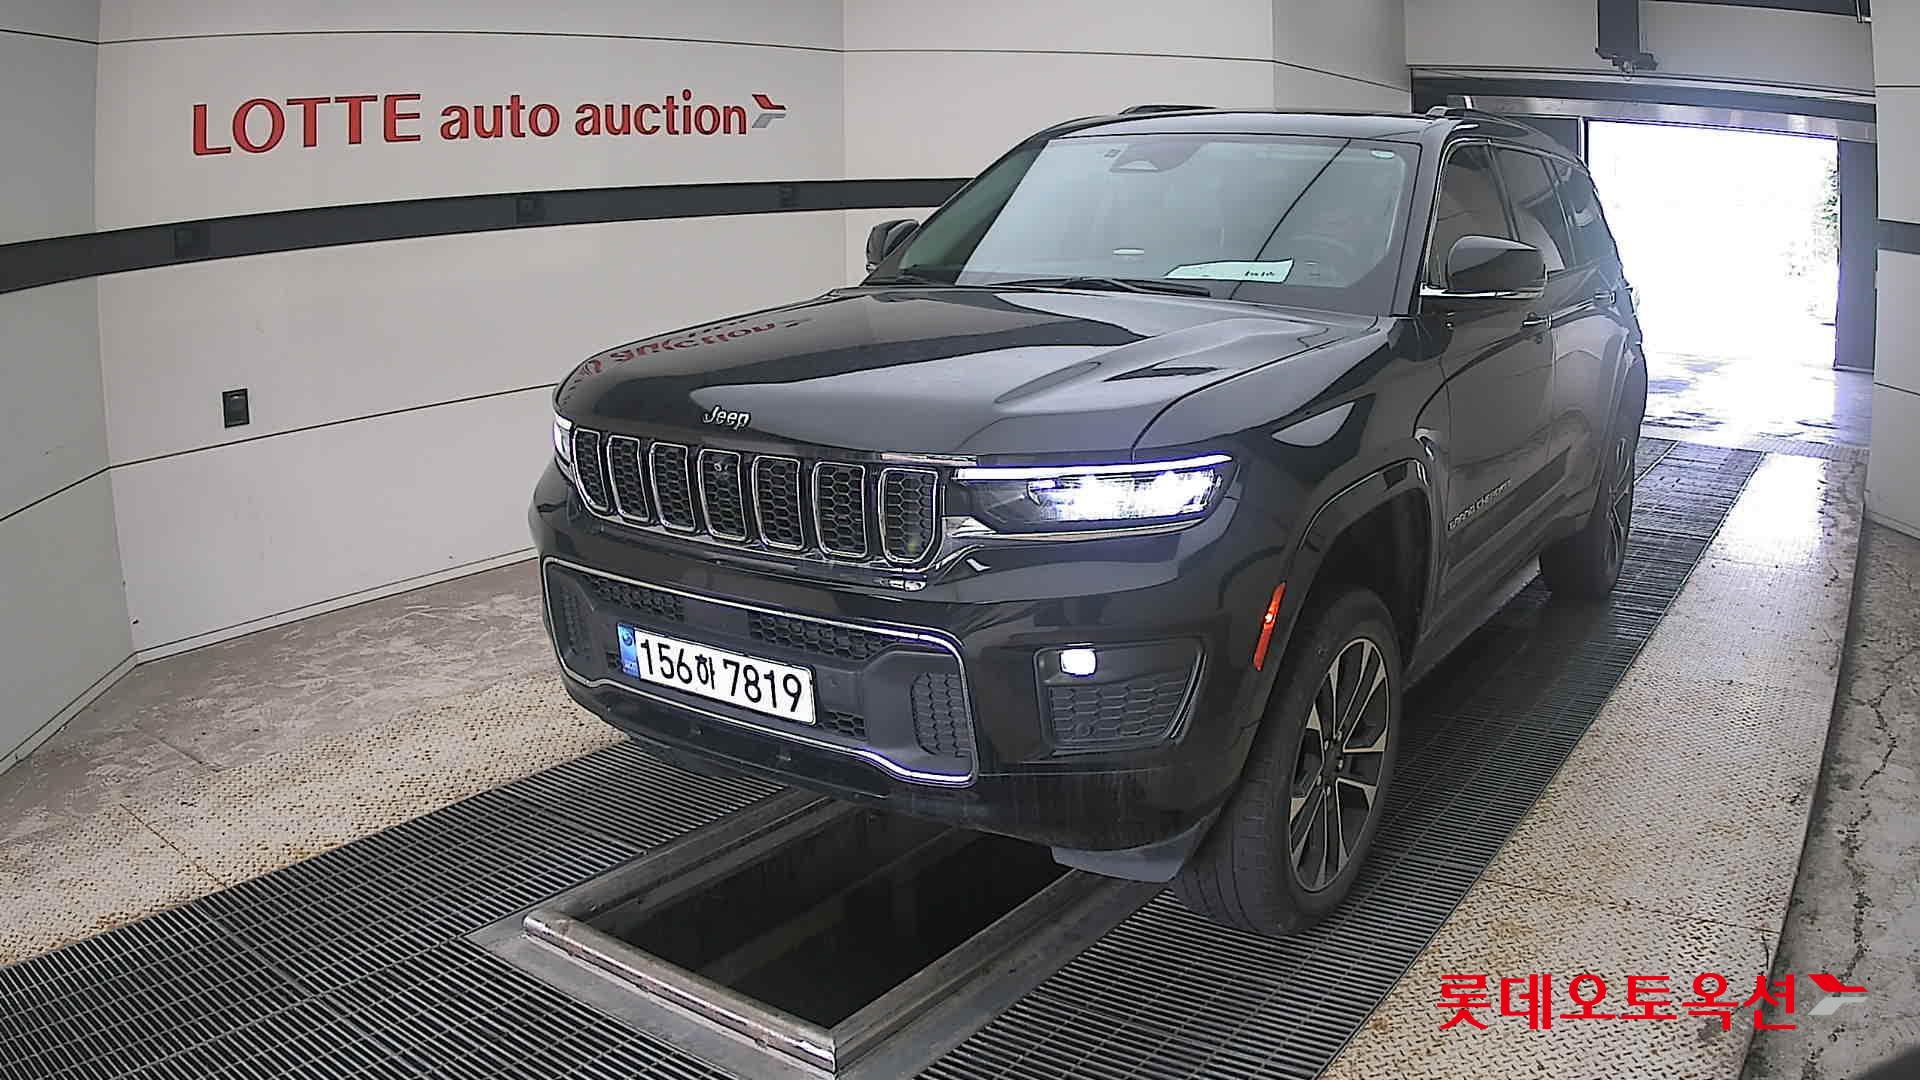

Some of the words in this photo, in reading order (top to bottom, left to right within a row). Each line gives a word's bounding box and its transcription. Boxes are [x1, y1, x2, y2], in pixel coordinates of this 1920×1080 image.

[192, 93, 422, 156] LOTTE
[439, 95, 561, 140] auto
[574, 89, 749, 138] auction
[702, 406, 750, 430] Jeep
